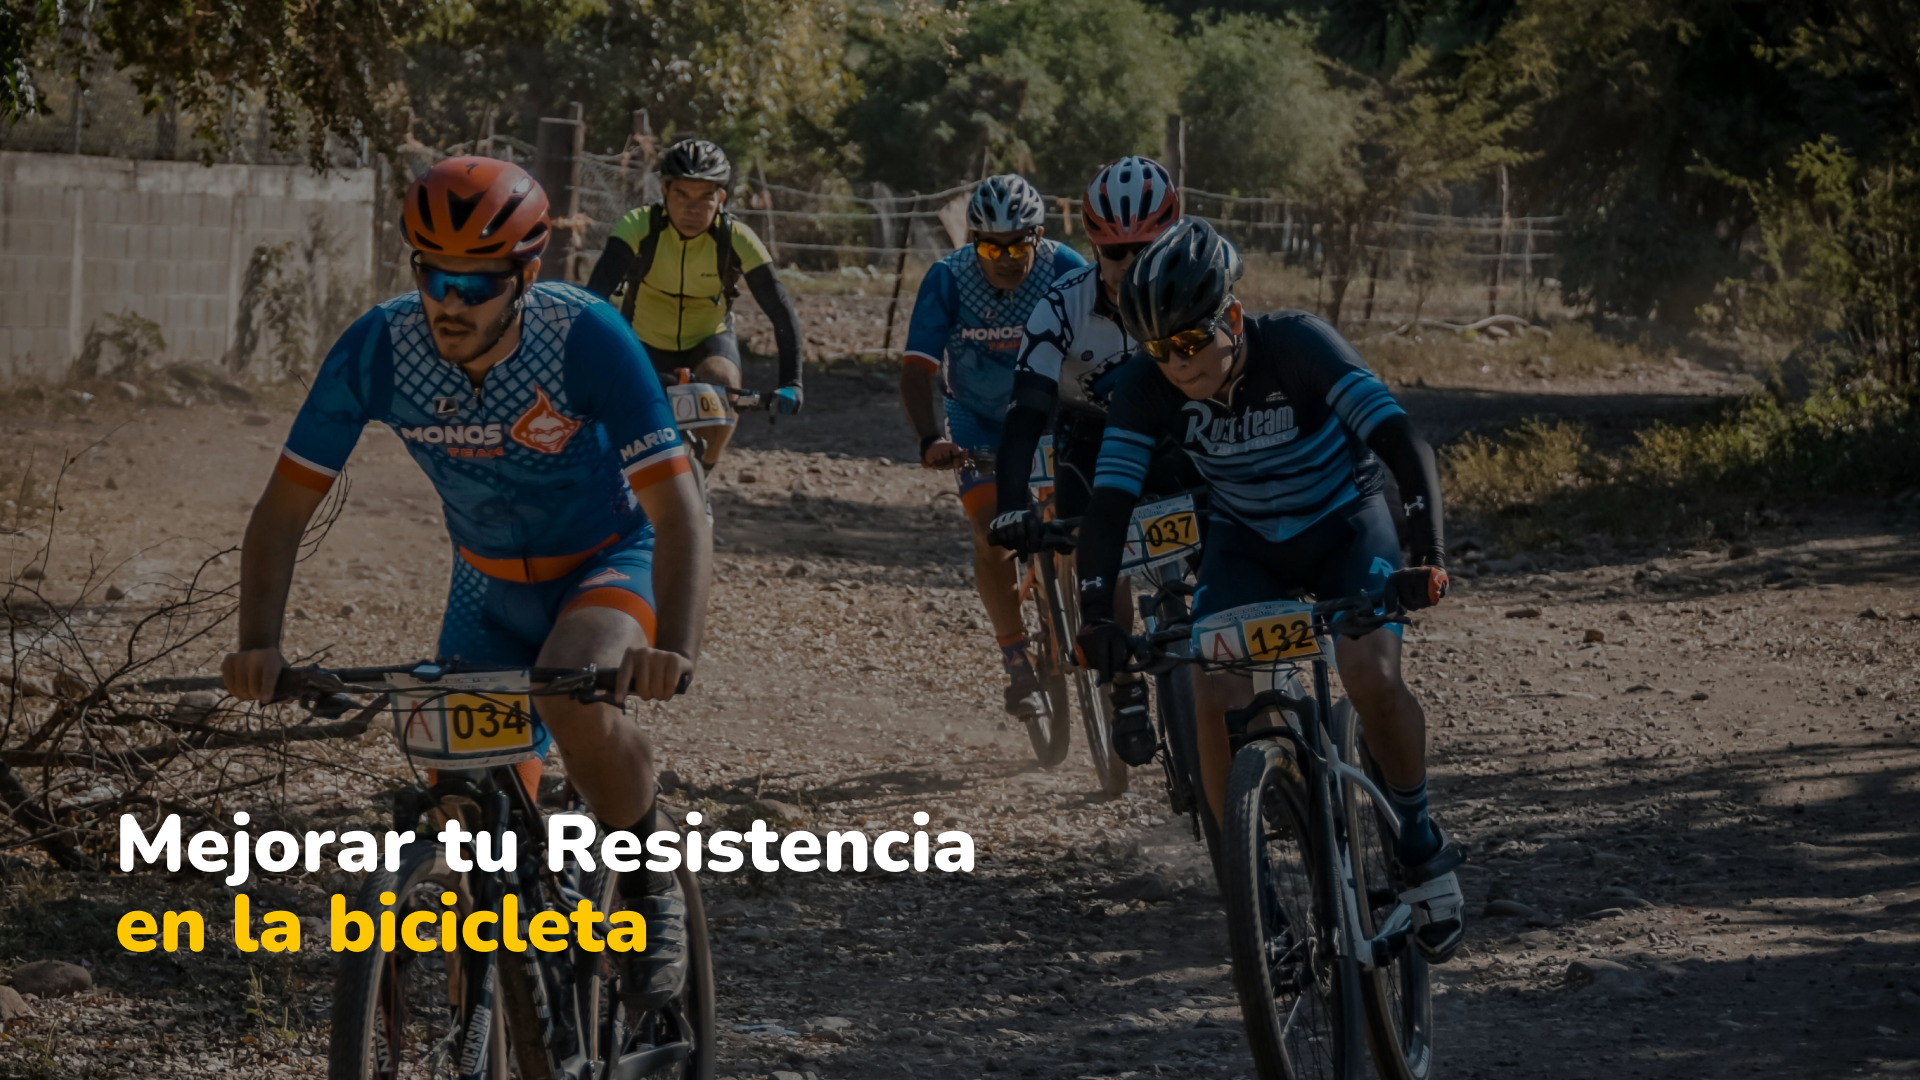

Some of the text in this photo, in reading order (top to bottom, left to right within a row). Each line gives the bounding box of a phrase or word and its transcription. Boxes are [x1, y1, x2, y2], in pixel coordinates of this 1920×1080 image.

[961, 325, 1024, 340] MONOS
[401, 423, 503, 445] MONOS
[619, 427, 677, 462] MARIO
[447, 446, 504, 459] TEAM
[1148, 515, 1192, 547] 037
[1251, 619, 1313, 654] 132
[409, 700, 526, 742] A 034
[459, 1003, 491, 1076] ROCKSHOX
